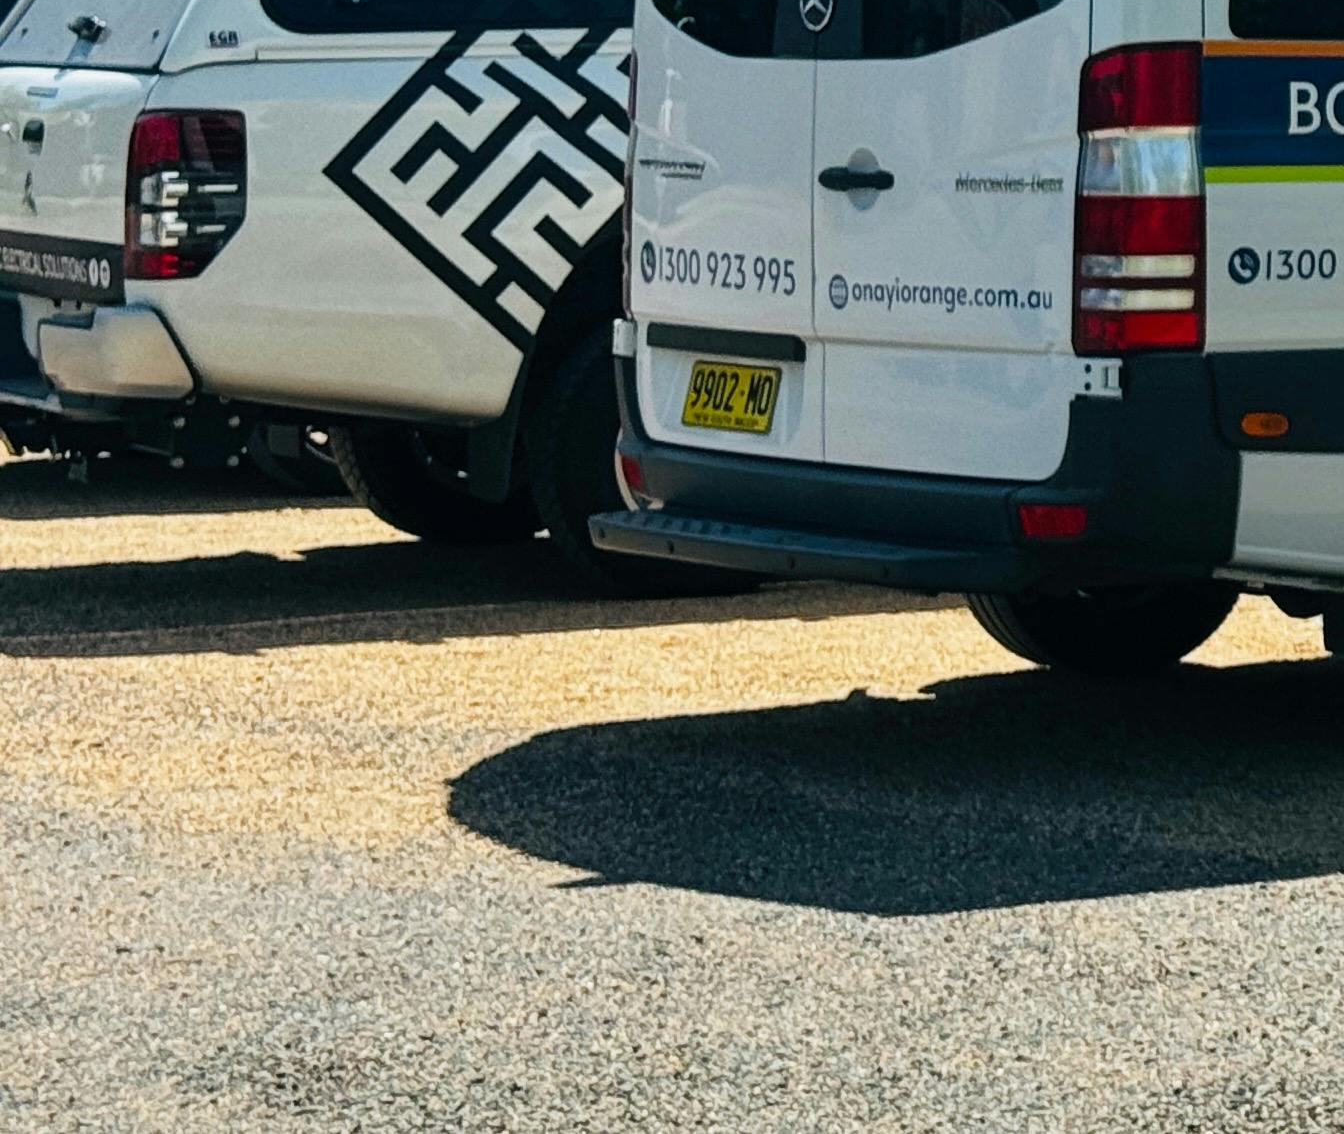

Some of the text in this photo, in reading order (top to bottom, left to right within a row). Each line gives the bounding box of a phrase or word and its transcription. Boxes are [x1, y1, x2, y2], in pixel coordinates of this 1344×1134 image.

[658, 248, 796, 296] 1300 923 995
[1265, 249, 1337, 281] 1300
[851, 277, 1053, 313] onayiorange.com.au
